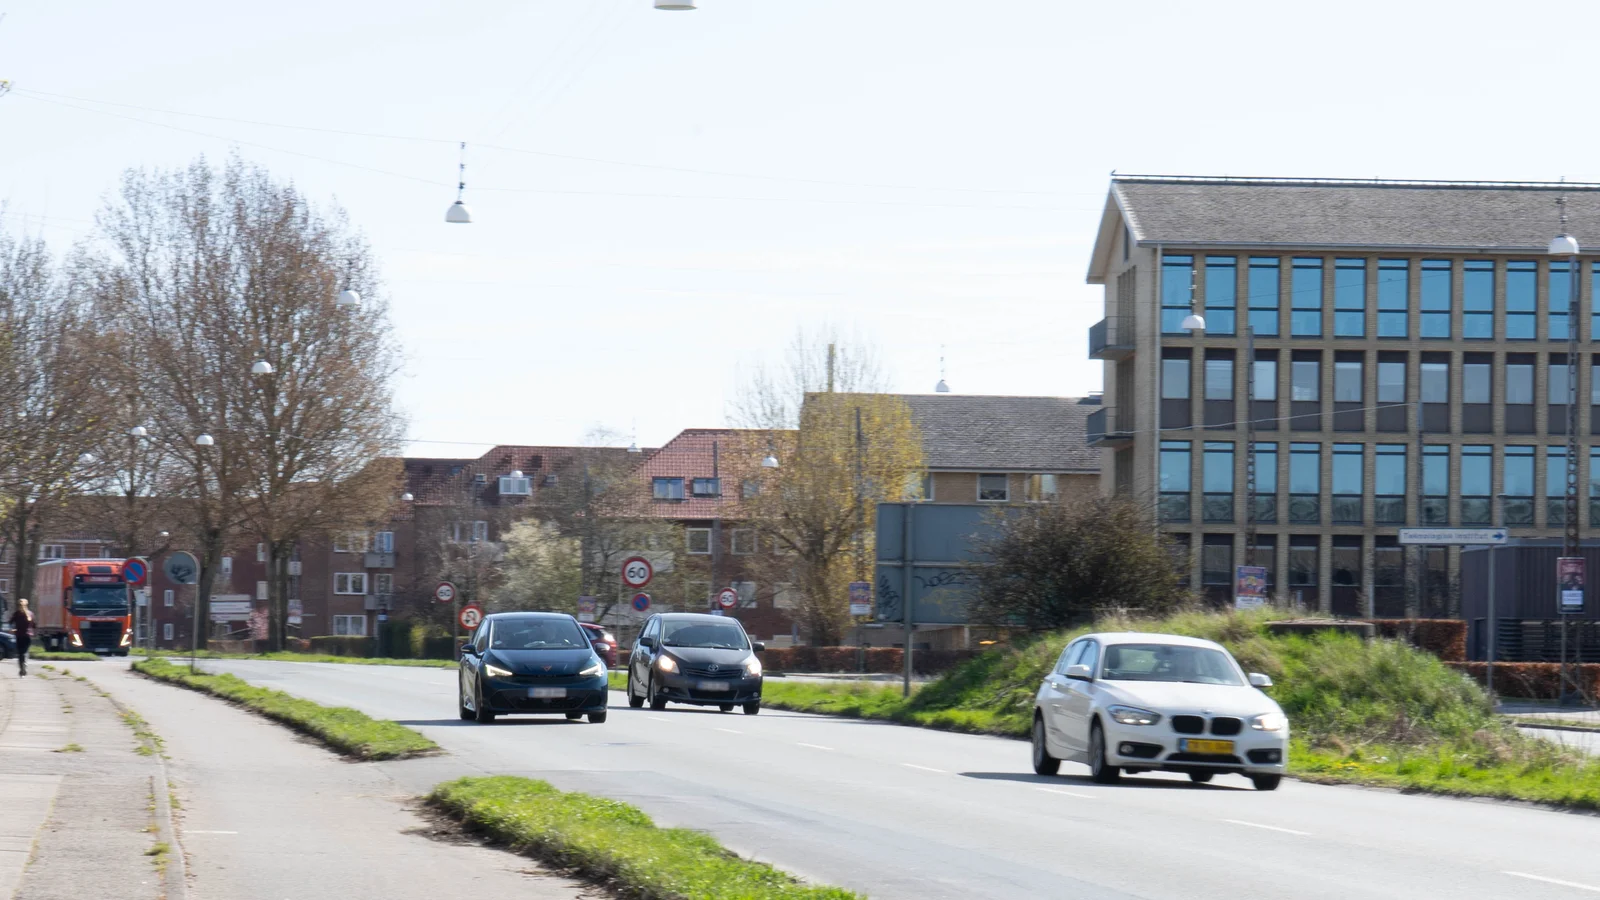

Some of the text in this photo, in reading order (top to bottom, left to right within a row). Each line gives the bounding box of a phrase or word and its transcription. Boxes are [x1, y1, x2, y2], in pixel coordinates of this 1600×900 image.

[627, 567, 647, 579] 60
[439, 589, 452, 597] 60
[721, 594, 734, 603] 60
